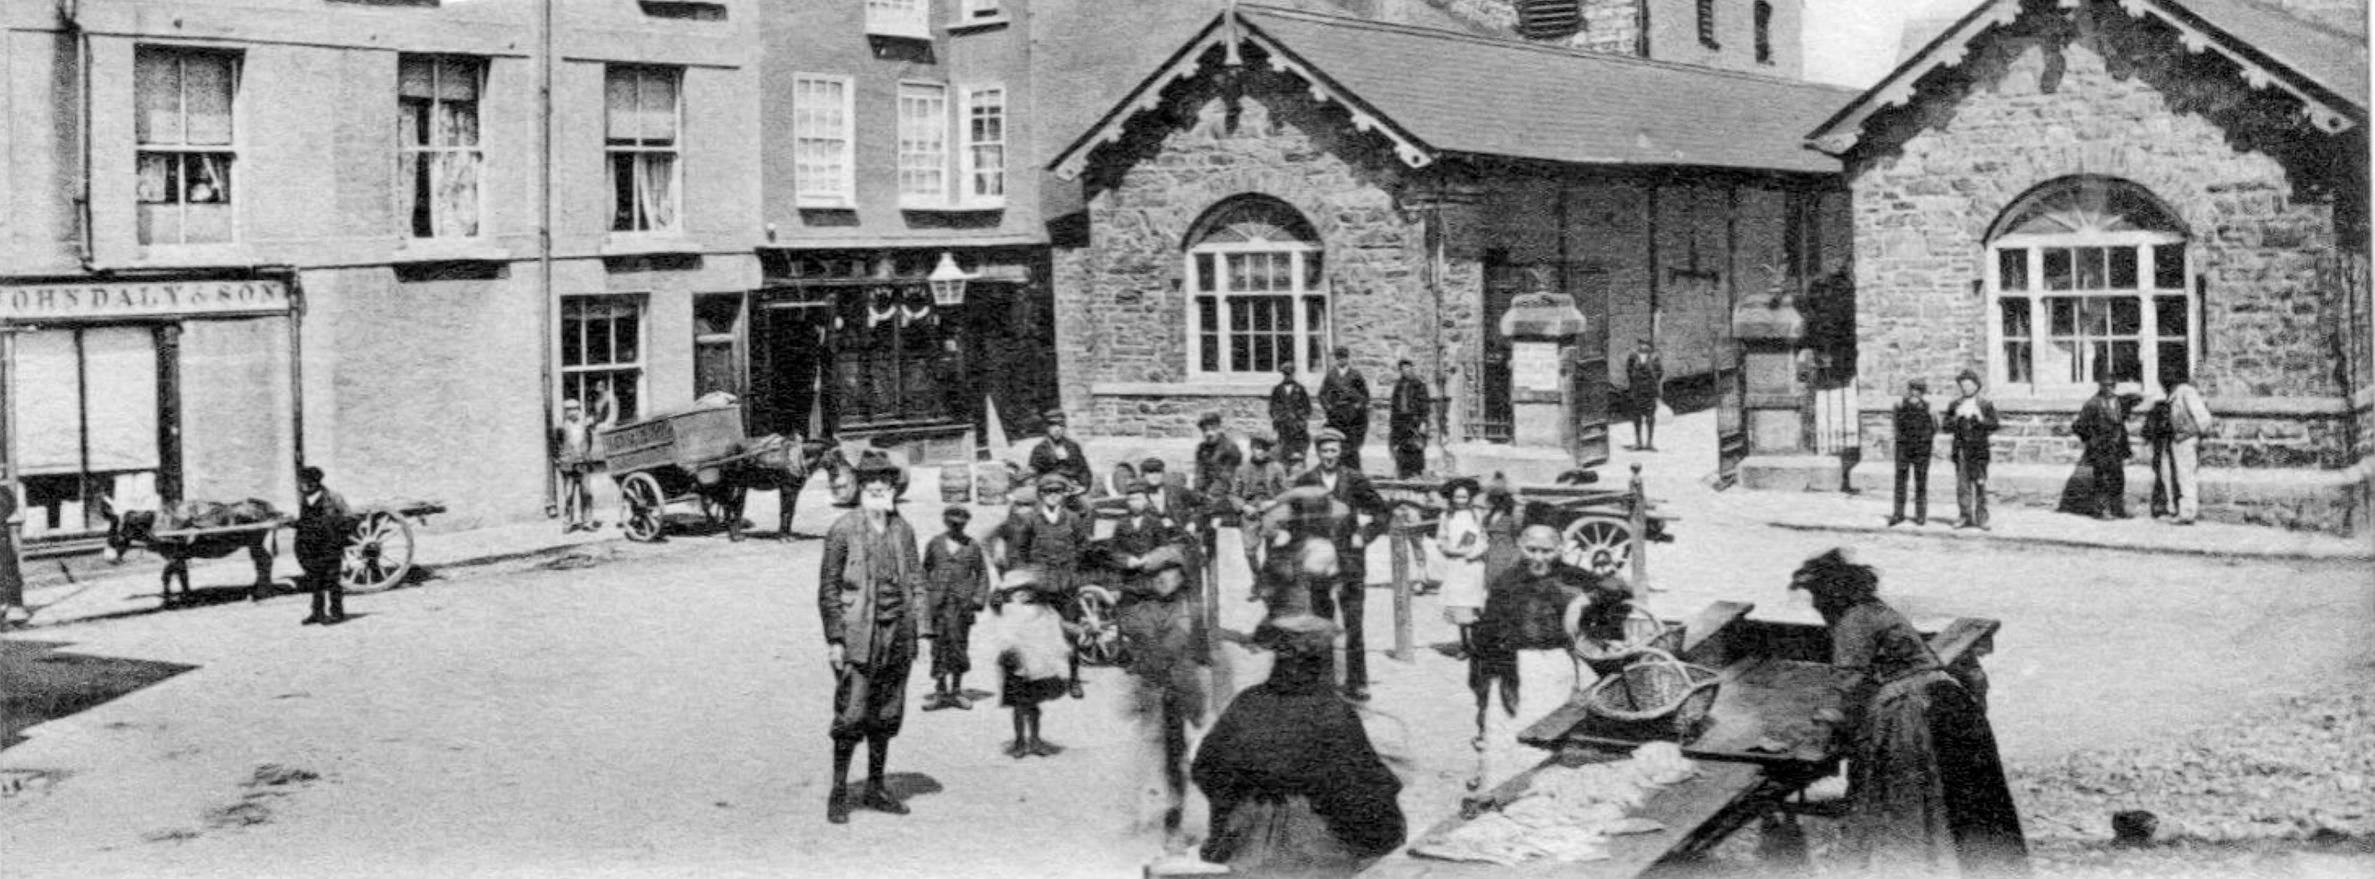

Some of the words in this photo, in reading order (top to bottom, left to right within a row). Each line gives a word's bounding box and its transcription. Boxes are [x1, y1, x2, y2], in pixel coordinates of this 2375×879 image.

[0, 288, 80, 310] OHN
[91, 286, 182, 308] DALY
[218, 283, 278, 303] SON
